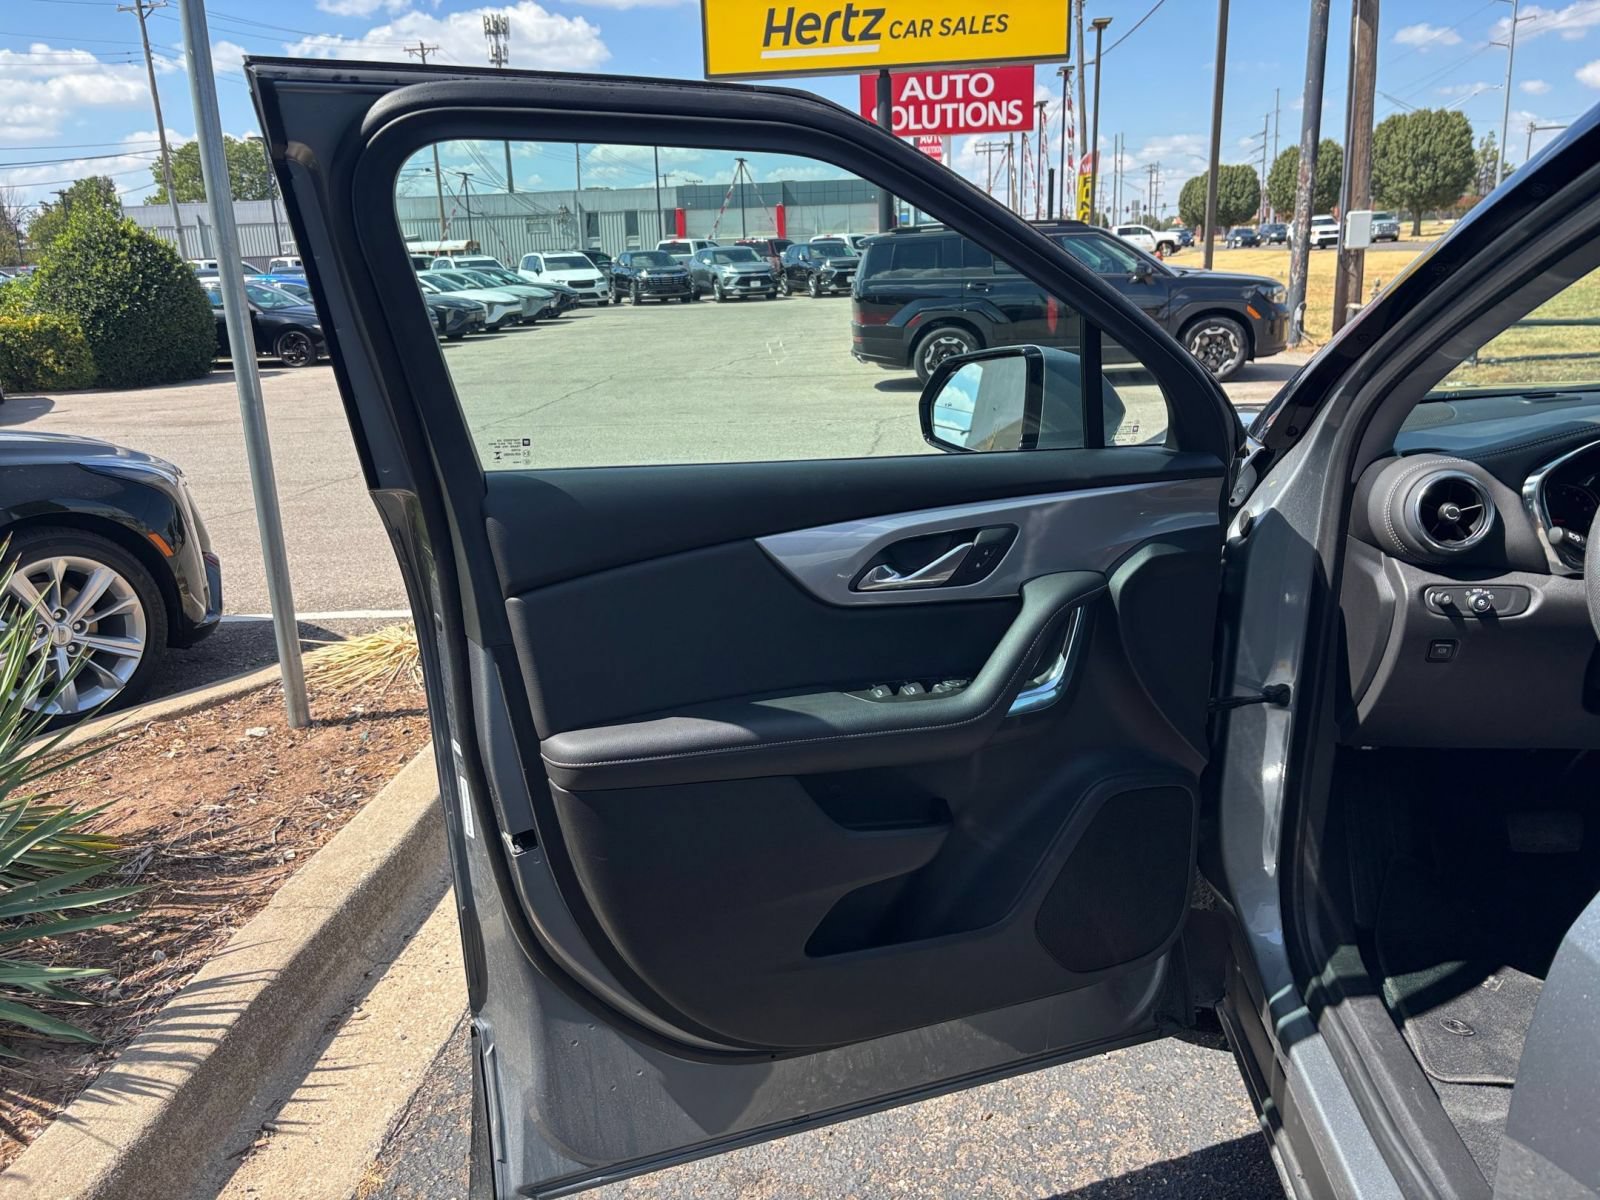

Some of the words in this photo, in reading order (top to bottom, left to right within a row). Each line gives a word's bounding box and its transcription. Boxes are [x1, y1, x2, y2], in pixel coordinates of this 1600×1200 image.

[762, 3, 886, 47] Hertz
[889, 19, 934, 39] CAR
[938, 14, 1009, 37] SALES
[900, 73, 995, 101] AUTO
